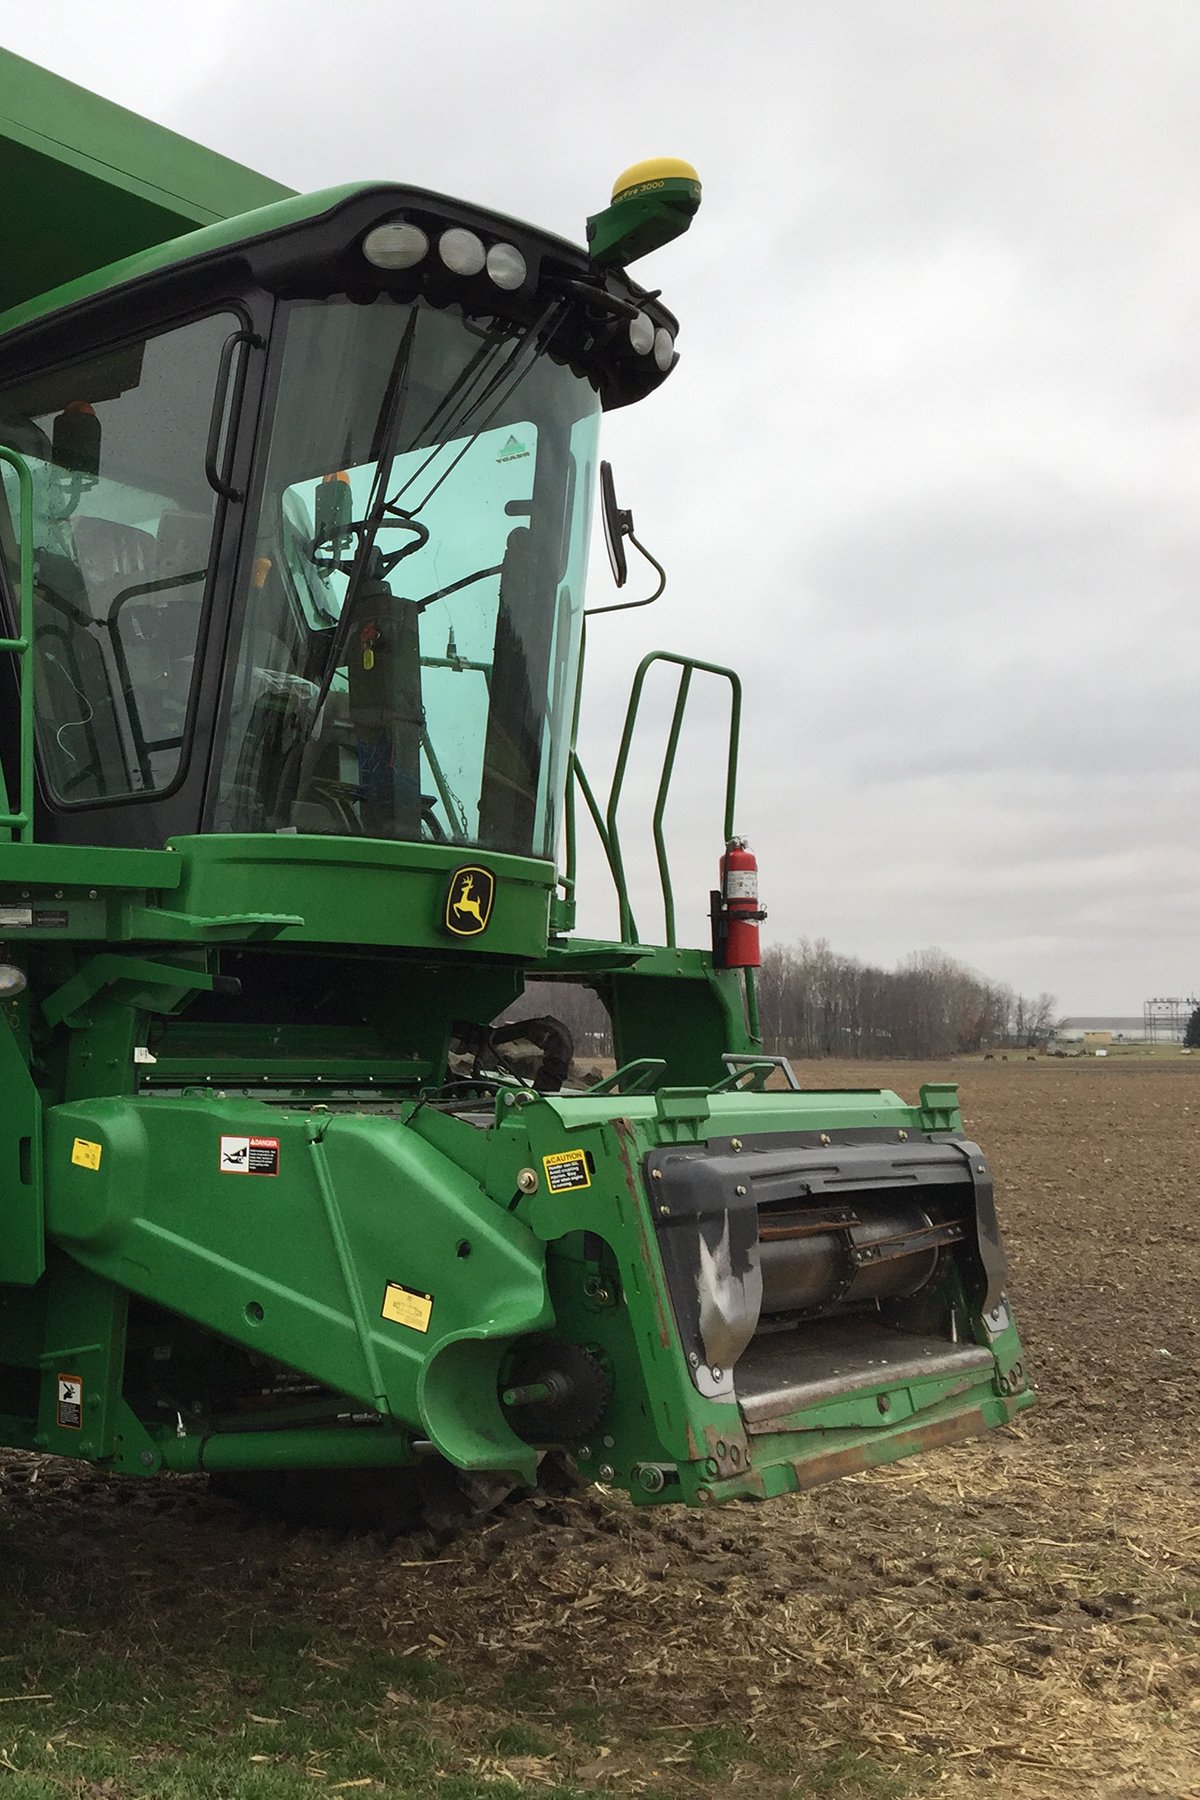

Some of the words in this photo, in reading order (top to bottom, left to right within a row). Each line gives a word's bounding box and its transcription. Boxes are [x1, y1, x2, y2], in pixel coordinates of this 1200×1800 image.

[640, 180, 665, 192] 3000
[254, 1139, 277, 1147] DANGER
[551, 1152, 582, 1163] CAUTION
